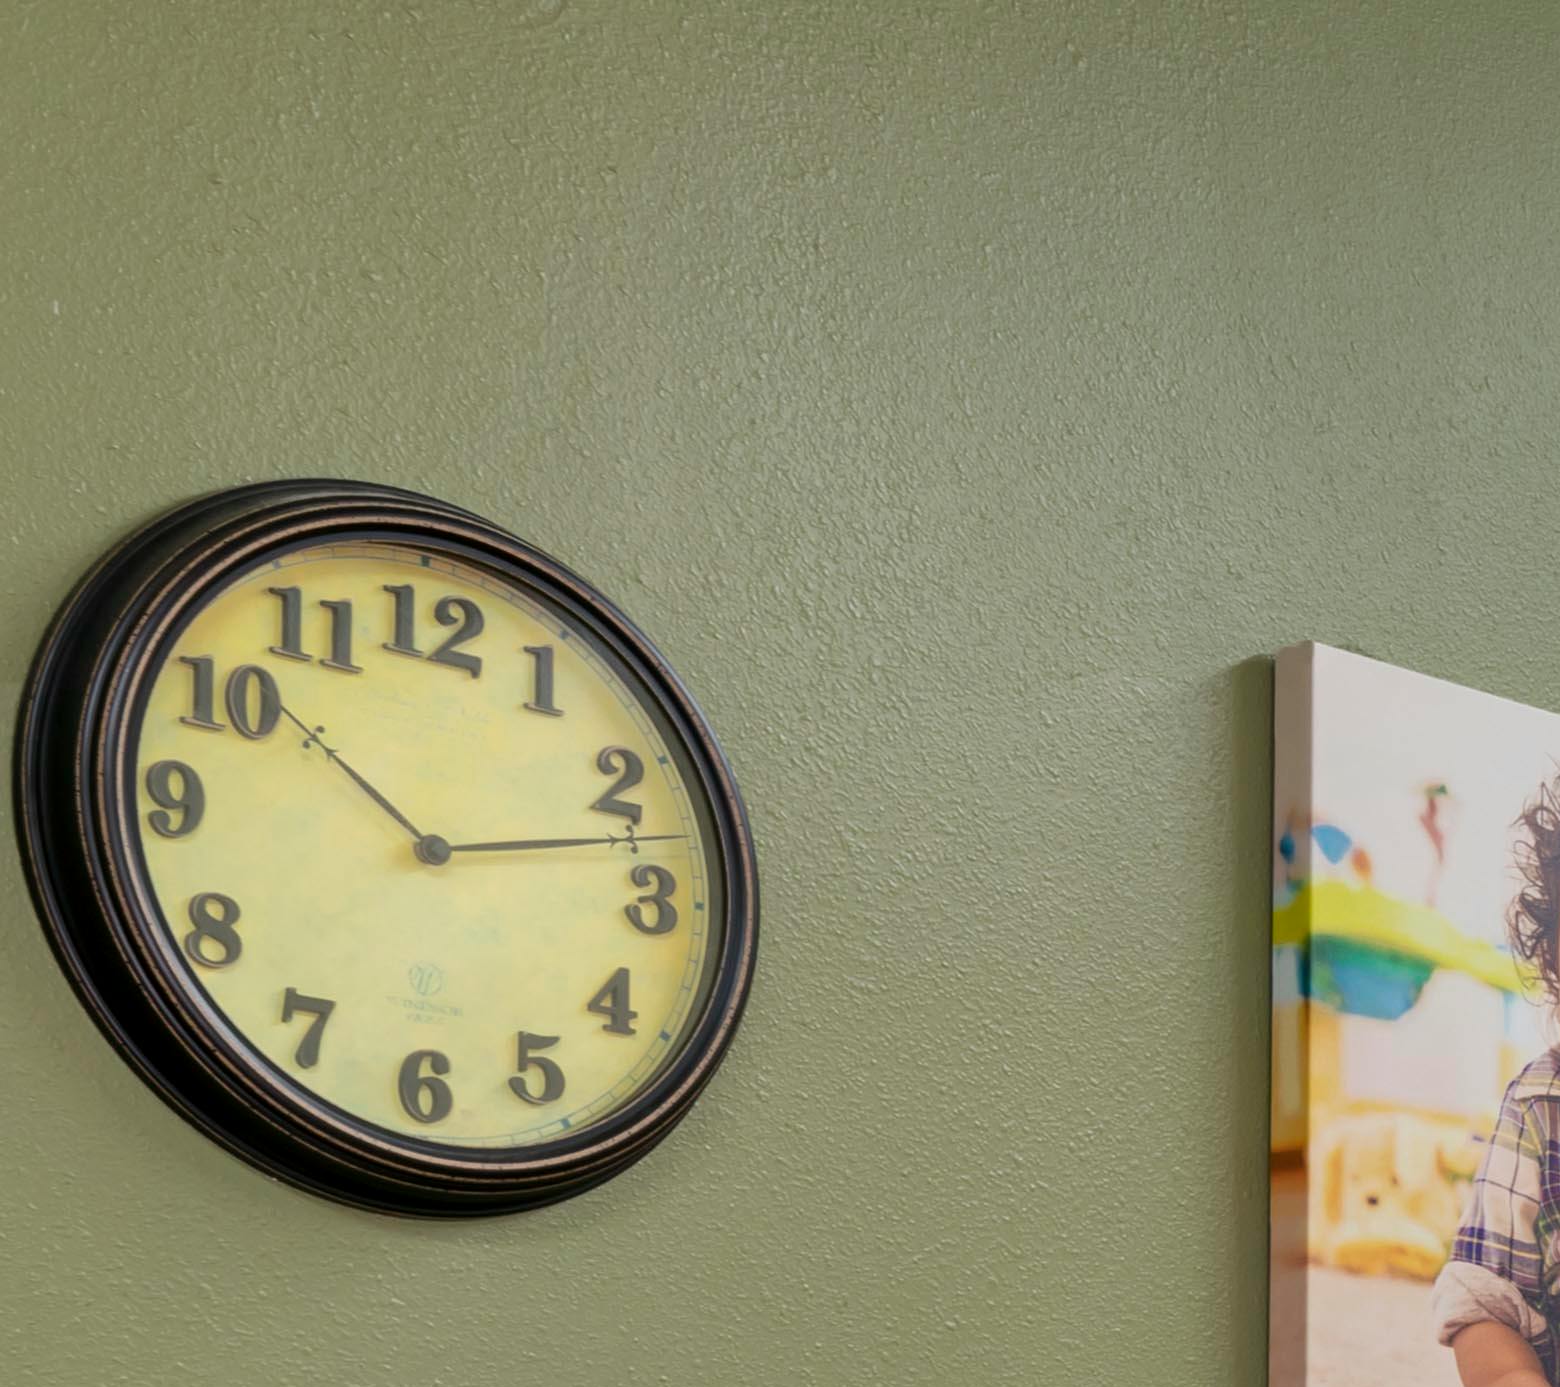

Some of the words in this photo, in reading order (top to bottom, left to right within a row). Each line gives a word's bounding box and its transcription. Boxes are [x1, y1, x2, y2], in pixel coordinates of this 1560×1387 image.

[269, 586, 363, 674] 11
[382, 584, 485, 679] 12
[179, 655, 281, 740] 10
[522, 644, 564, 717] 1
[145, 759, 206, 839] 9
[590, 745, 645, 826] 2
[184, 892, 243, 969] 8
[625, 864, 678, 936] 3
[280, 986, 338, 1069] 7
[587, 967, 639, 1036] 4
[399, 1049, 453, 1125] 6
[507, 1031, 566, 1105] 5
